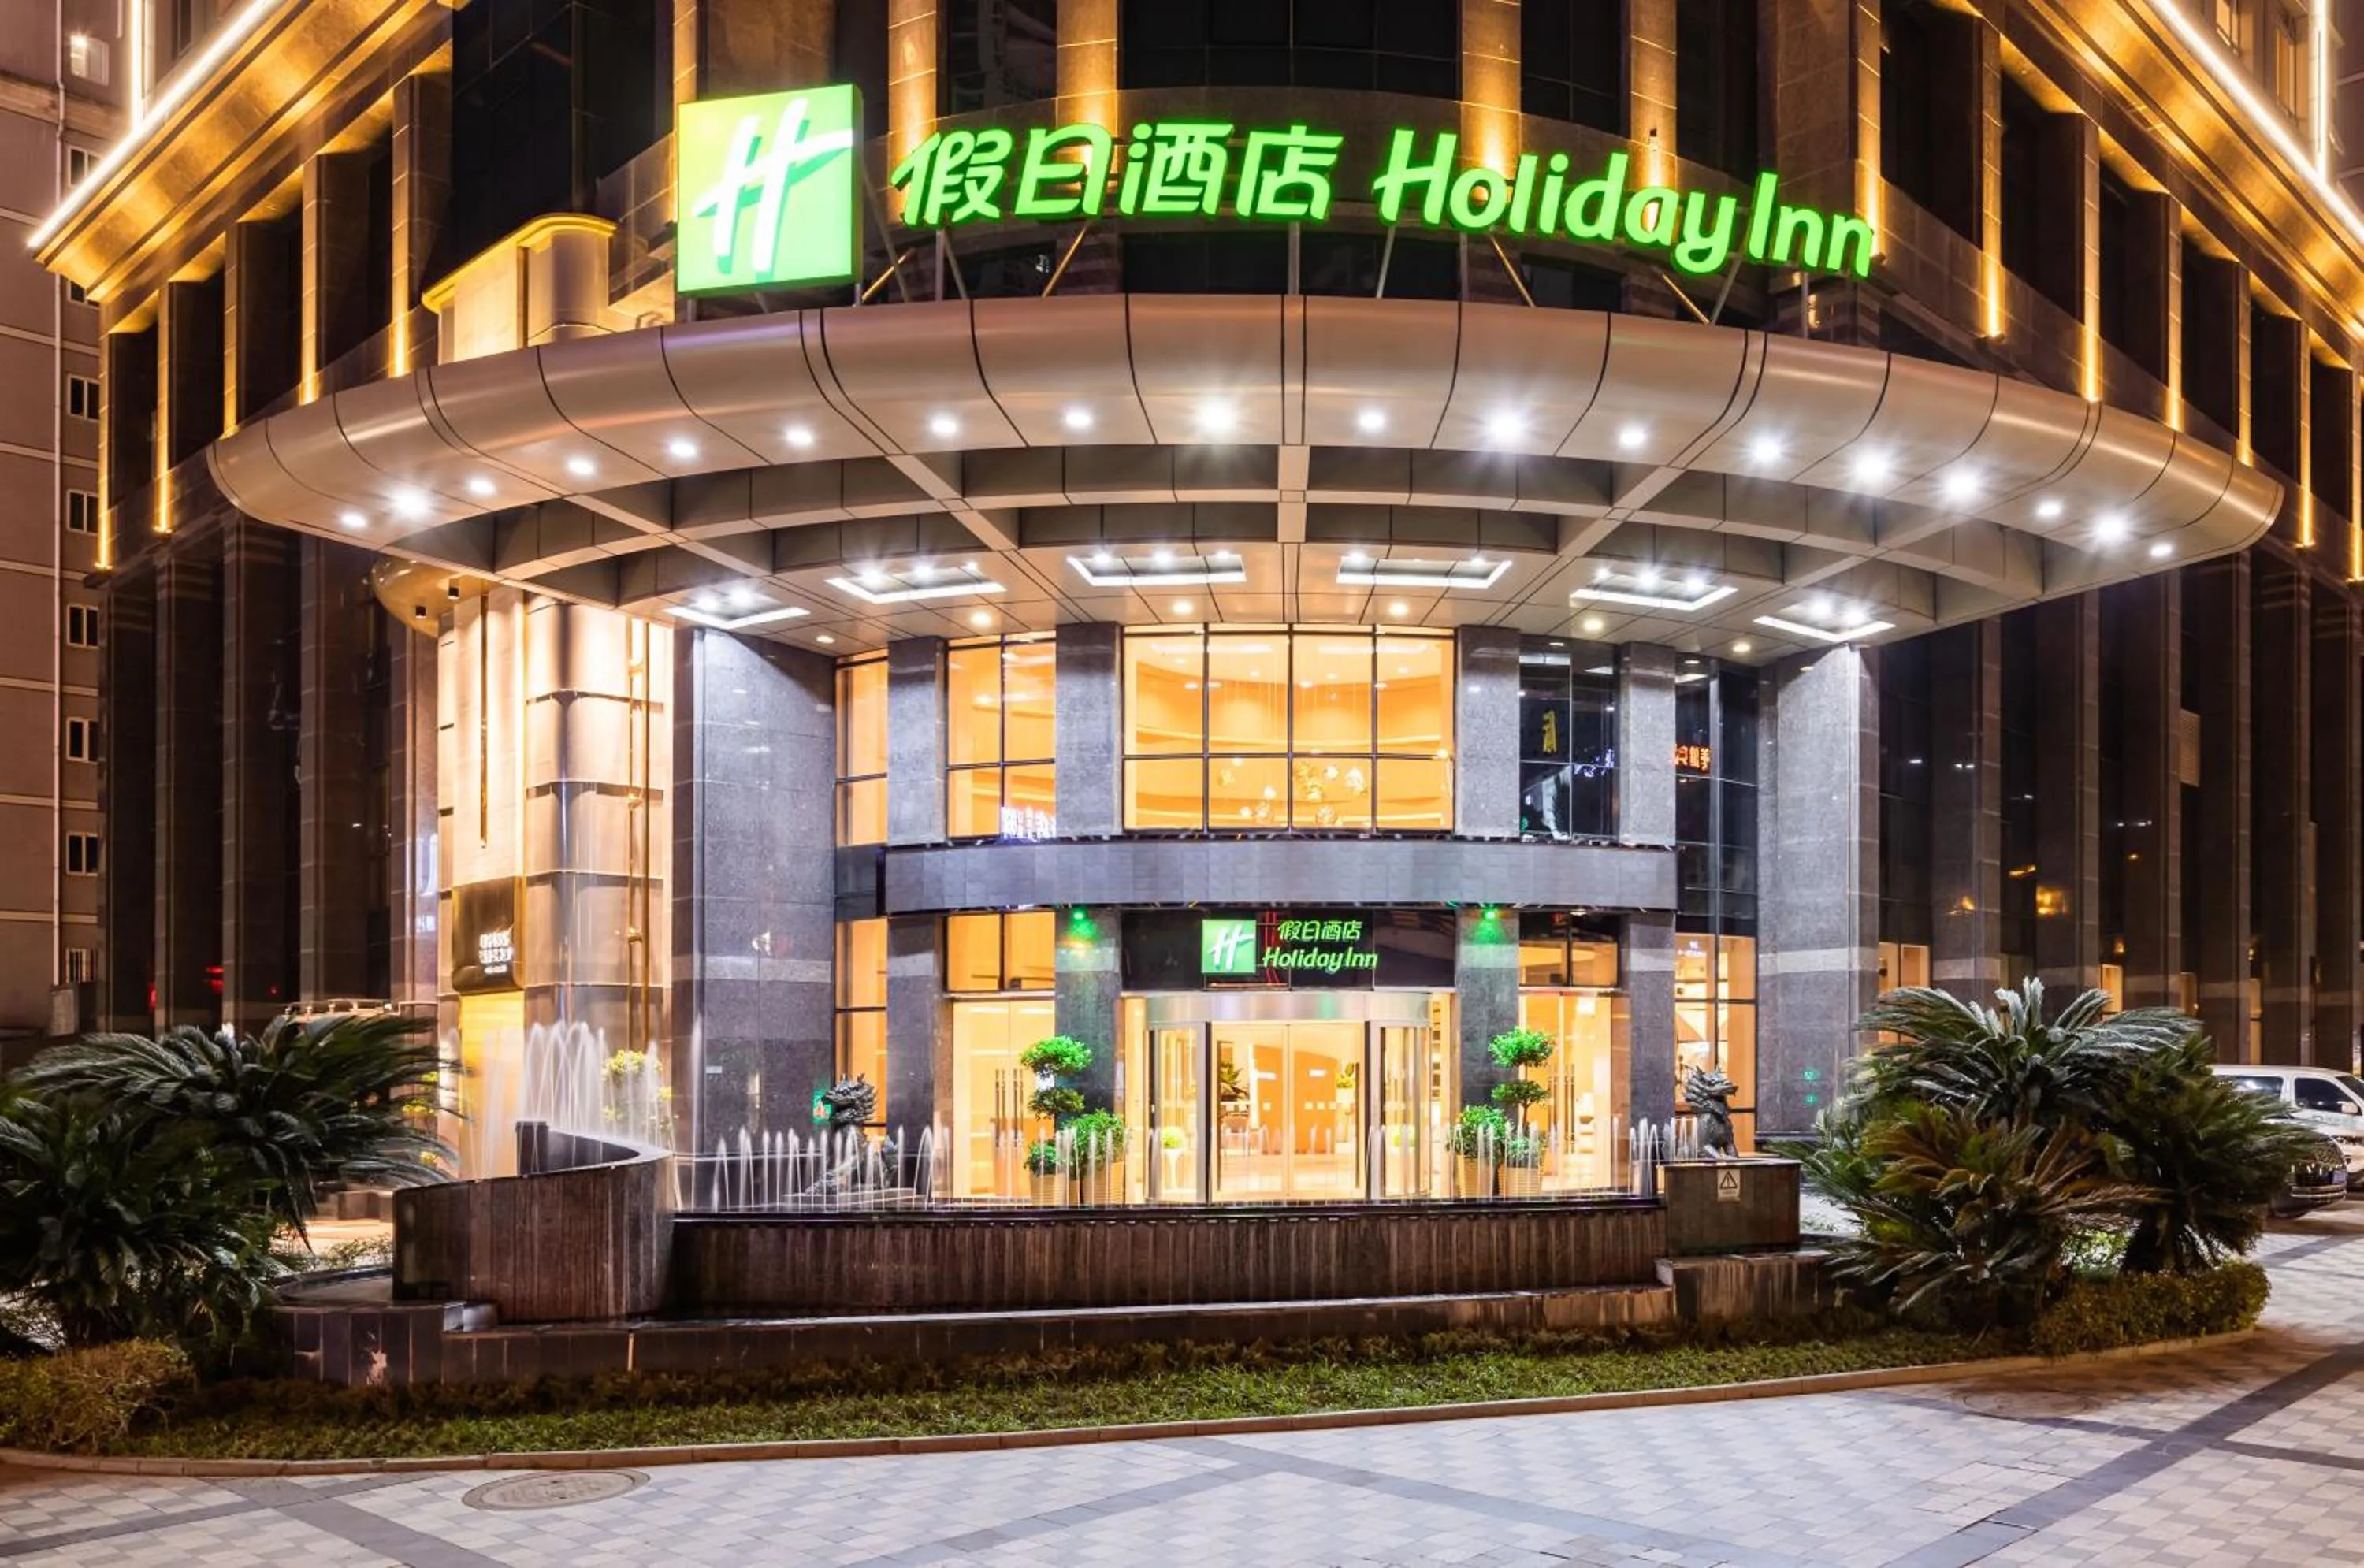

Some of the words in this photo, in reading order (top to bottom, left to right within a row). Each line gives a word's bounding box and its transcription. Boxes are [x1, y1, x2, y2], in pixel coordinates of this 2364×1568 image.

[890, 122, 1344, 226] 假日酒店
[1373, 128, 1738, 275] Holiday
[1748, 172, 1874, 278] Inn
[1262, 946, 1345, 974] Holiday
[1346, 947, 1378, 968] Inn
[1278, 920, 1362, 941] 假日酒店
